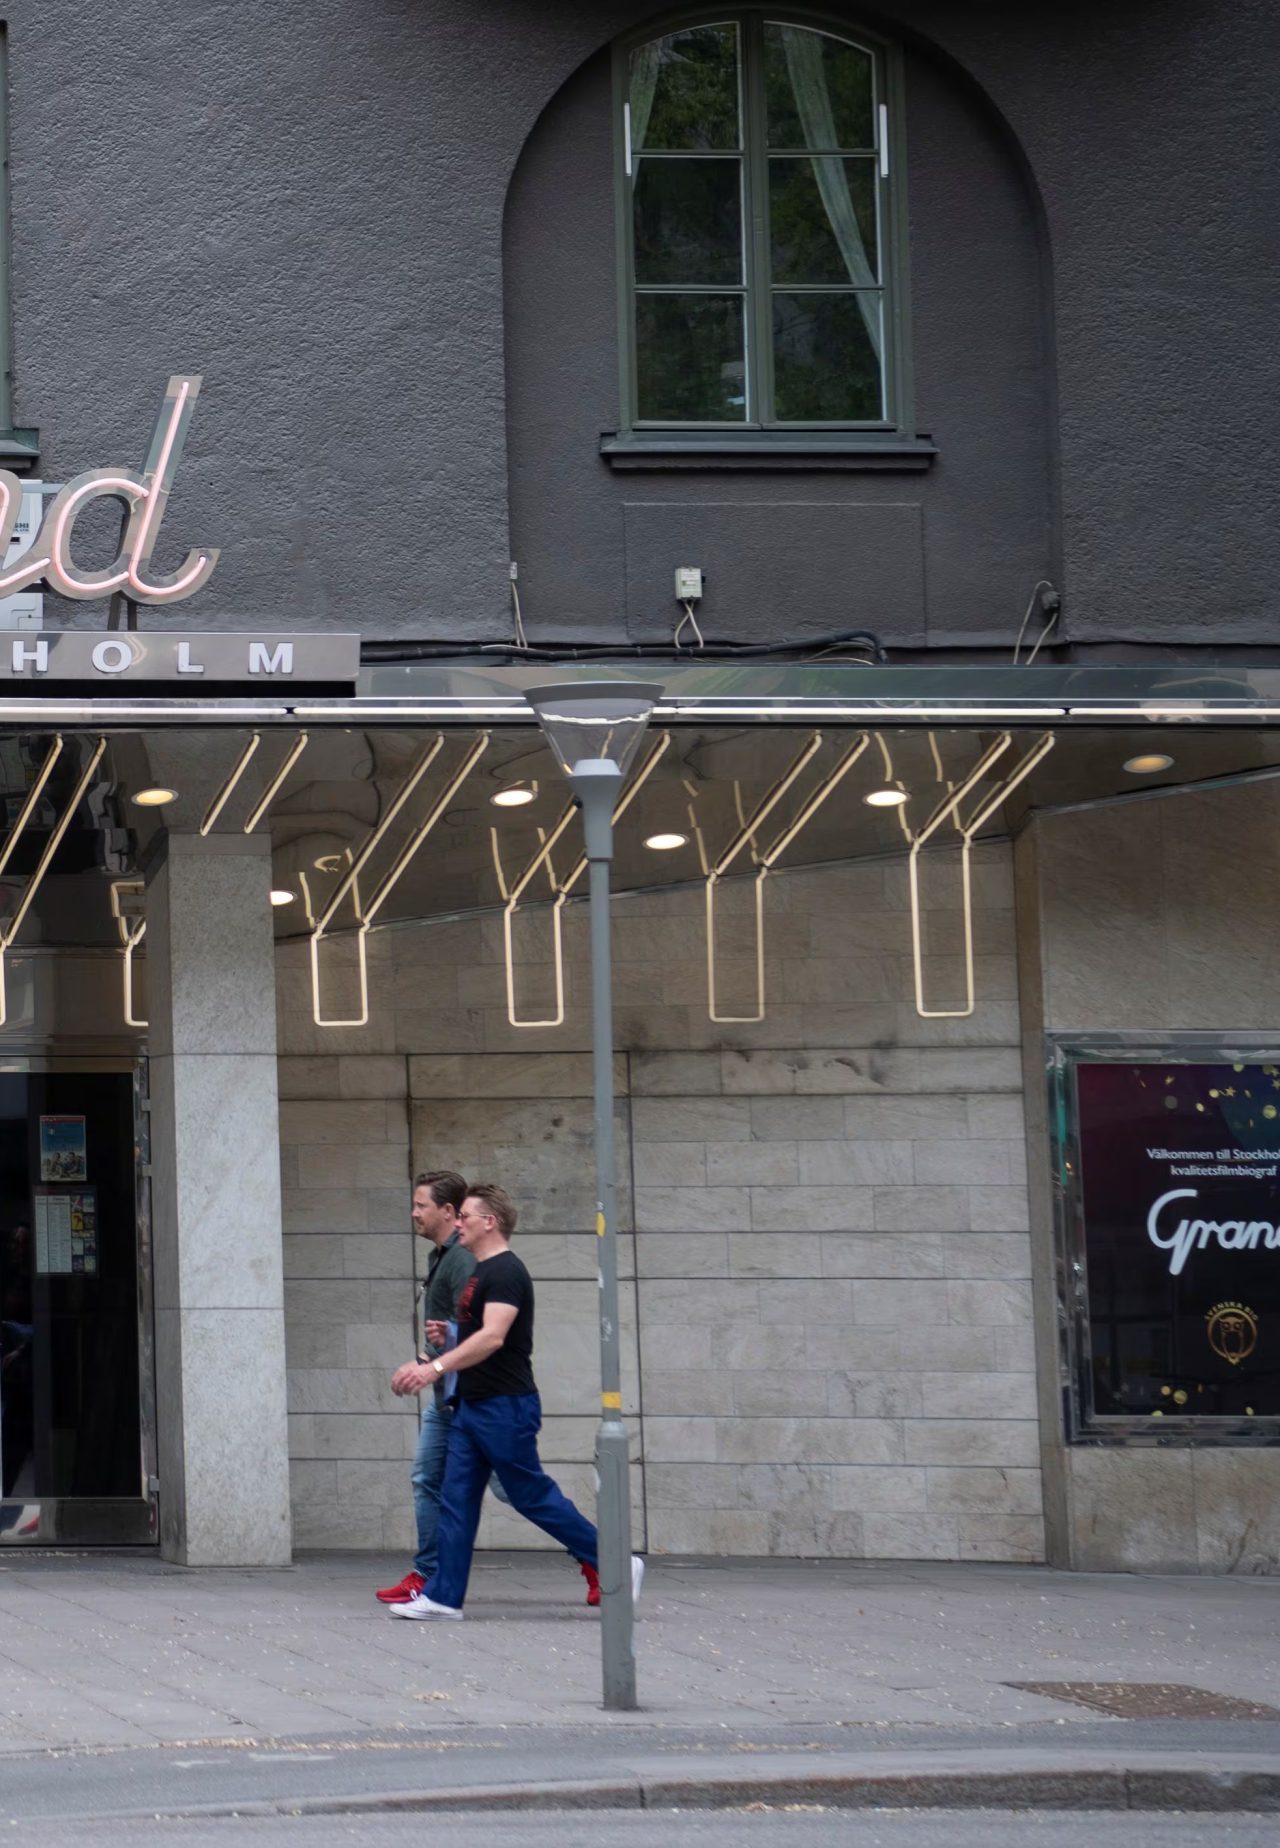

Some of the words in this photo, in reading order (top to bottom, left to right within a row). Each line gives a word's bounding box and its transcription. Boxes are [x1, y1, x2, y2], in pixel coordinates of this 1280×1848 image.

[1147, 1148, 1214, 1160] Välkommen
[1216, 1148, 1231, 1160] till
[1170, 1165, 1277, 1179] kvalitetsfilmbiograf
[1146, 1188, 1280, 1276] Gran
[1204, 1301, 1243, 1320] SVENSKA
[1244, 1306, 1259, 1321] BIO
